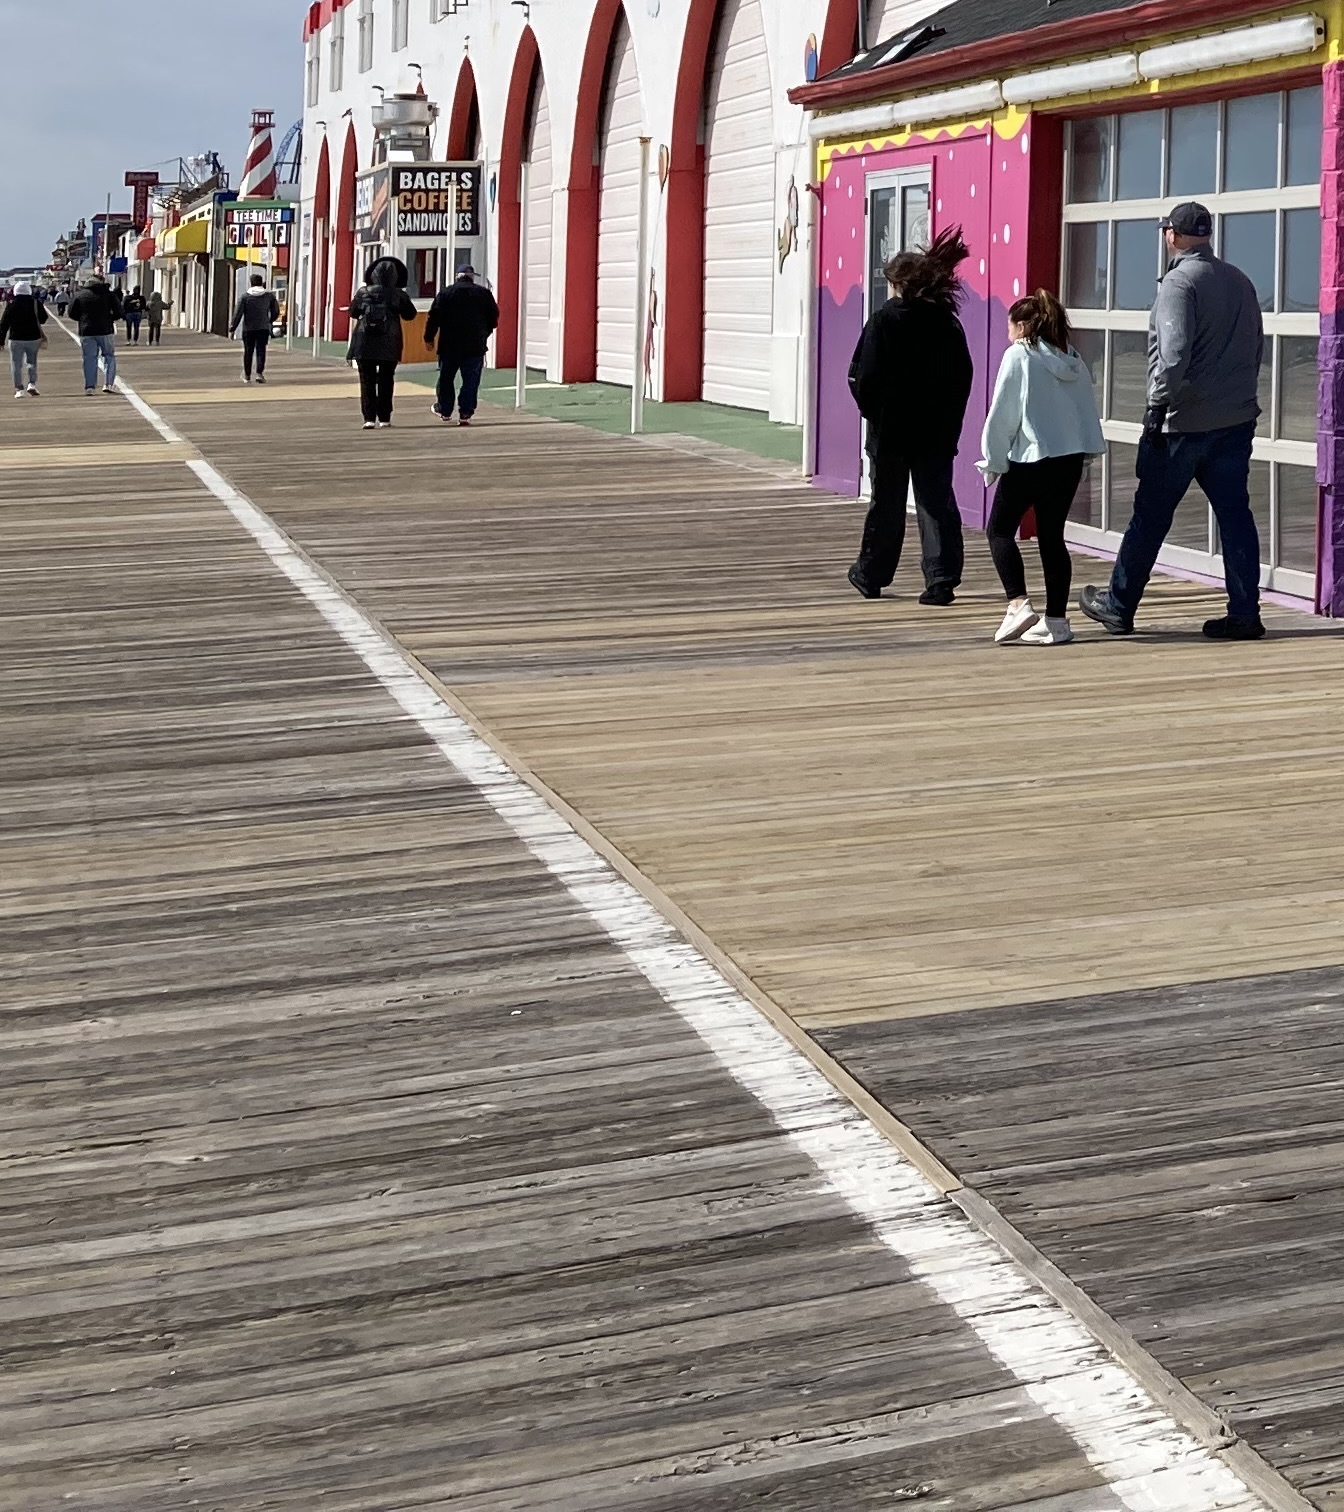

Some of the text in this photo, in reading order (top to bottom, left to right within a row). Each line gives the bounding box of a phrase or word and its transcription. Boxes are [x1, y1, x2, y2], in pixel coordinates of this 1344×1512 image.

[400, 172, 472, 189] BAGELS
[237, 209, 278, 221] TEE TIME
[398, 213, 472, 231] SANDWICES
[230, 225, 284, 243] GOLF
